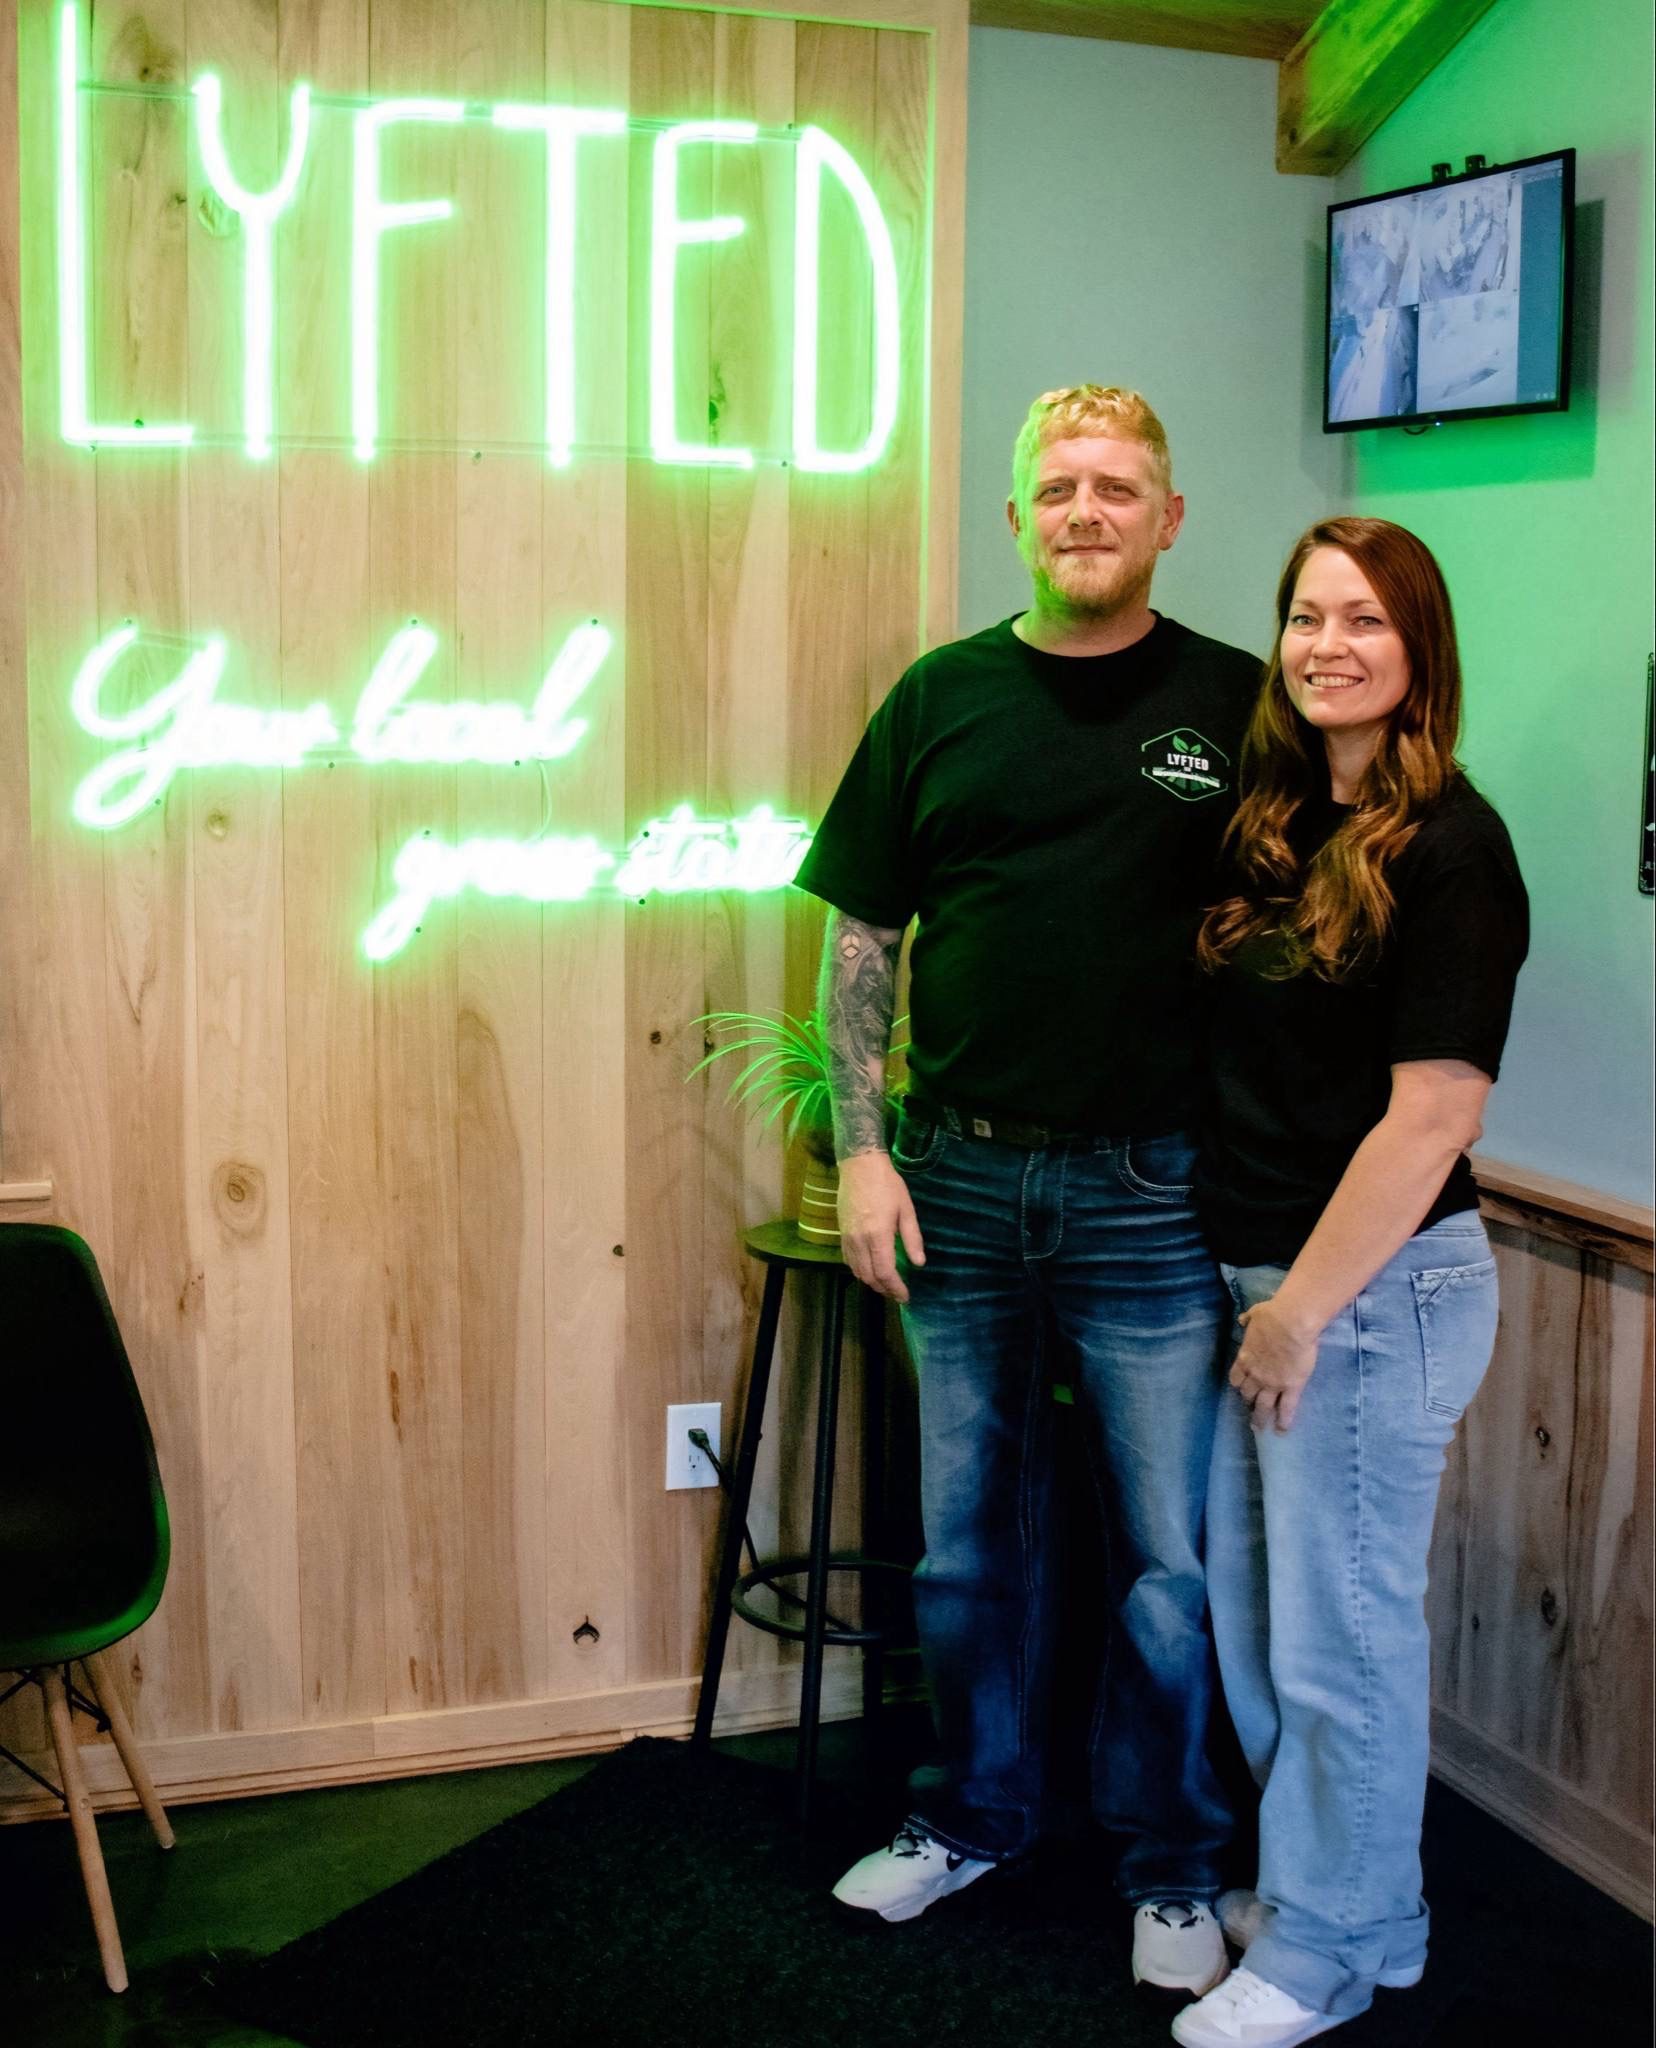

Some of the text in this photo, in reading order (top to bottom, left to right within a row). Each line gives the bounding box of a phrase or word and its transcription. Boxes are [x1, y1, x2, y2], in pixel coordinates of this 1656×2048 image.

[57, 0, 902, 475] LYFTED
[69, 621, 616, 831] Your local
[1167, 753, 1209, 771] LYFTED
